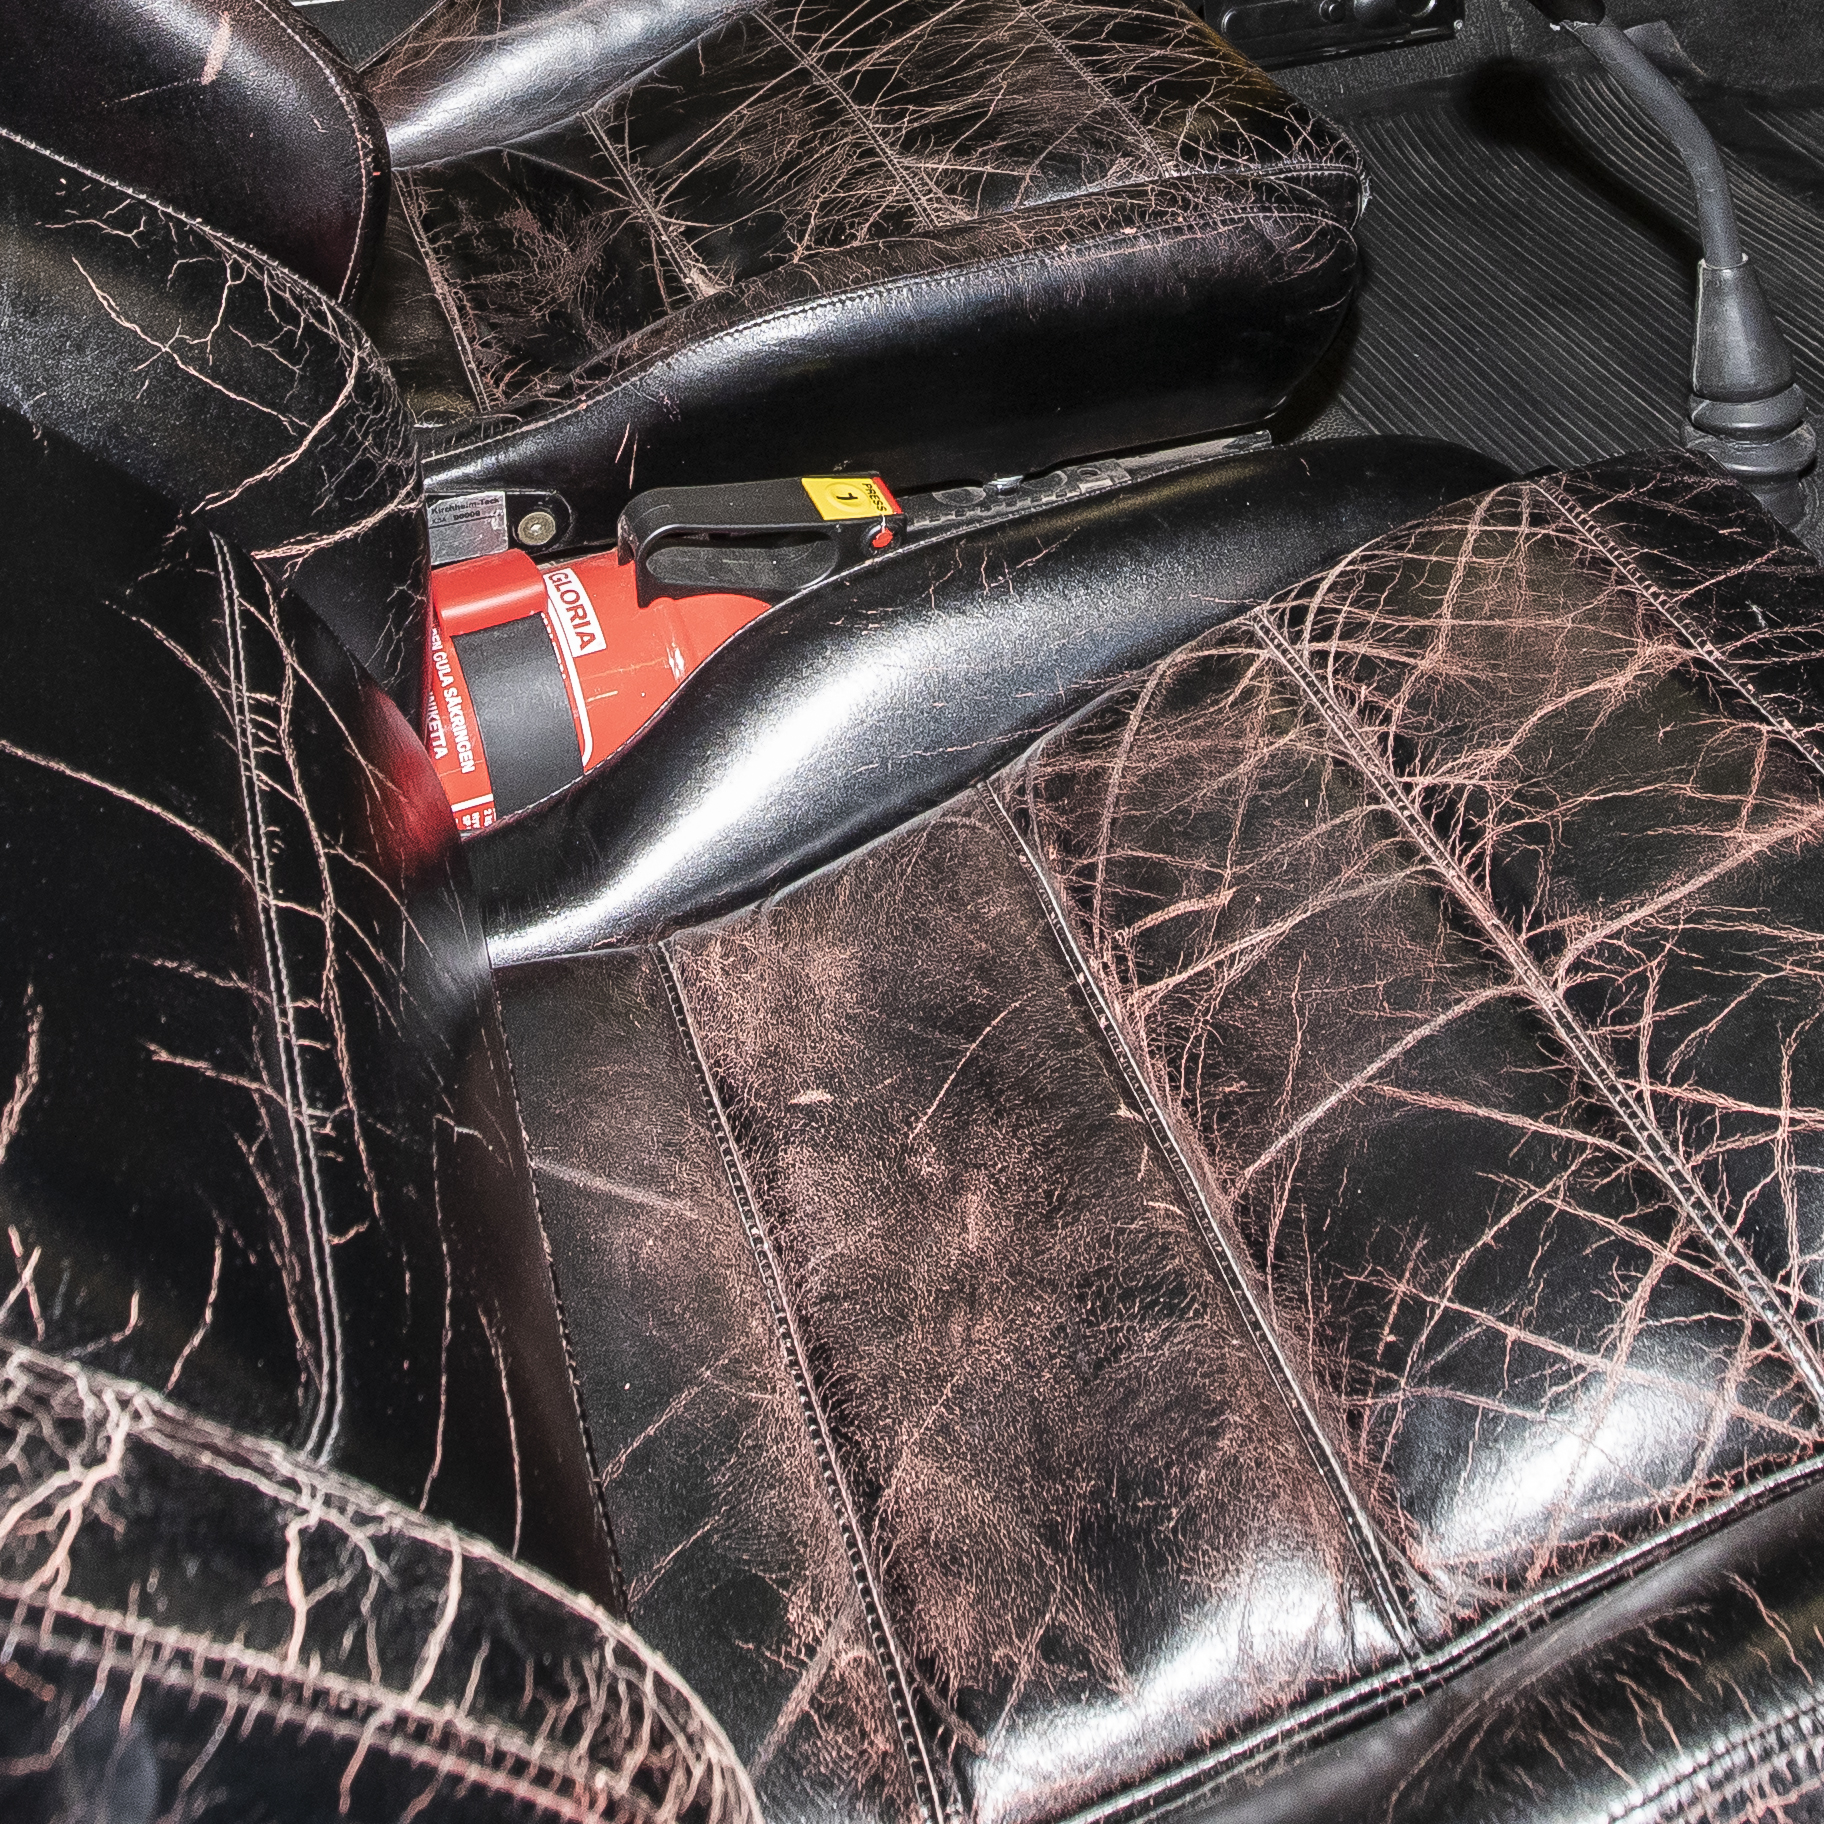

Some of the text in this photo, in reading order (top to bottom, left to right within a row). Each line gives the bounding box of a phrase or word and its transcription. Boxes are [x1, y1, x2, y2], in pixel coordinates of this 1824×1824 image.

[836, 492, 858, 501] 1
[862, 482, 888, 512] PRESS
[548, 571, 597, 651] GLORIA
[433, 651, 454, 688] GULA
